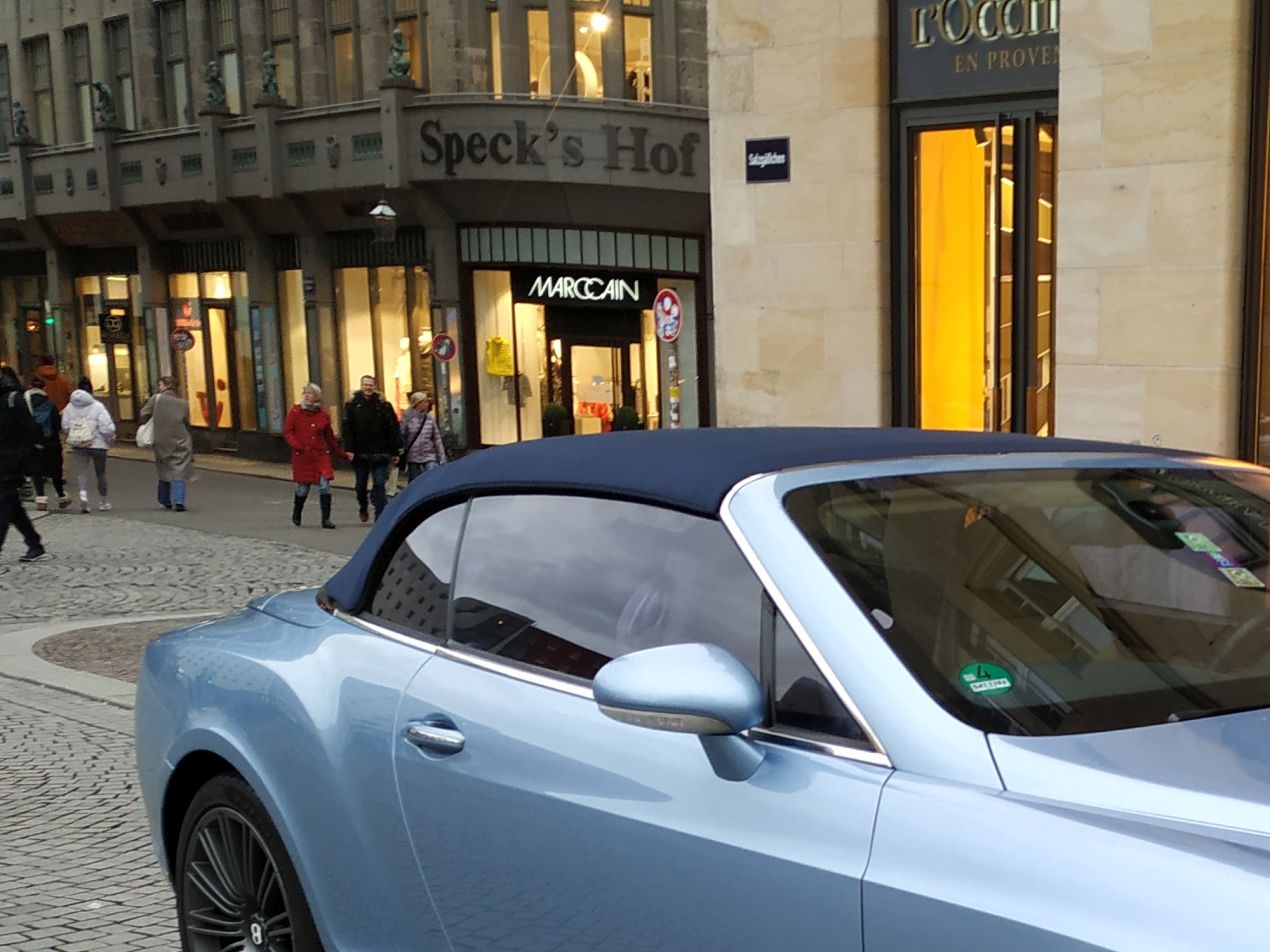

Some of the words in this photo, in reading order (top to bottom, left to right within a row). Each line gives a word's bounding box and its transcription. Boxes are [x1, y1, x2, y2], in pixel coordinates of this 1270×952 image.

[955, 52, 979, 72] EN
[420, 119, 585, 176] Speck's
[602, 124, 700, 177] Hof
